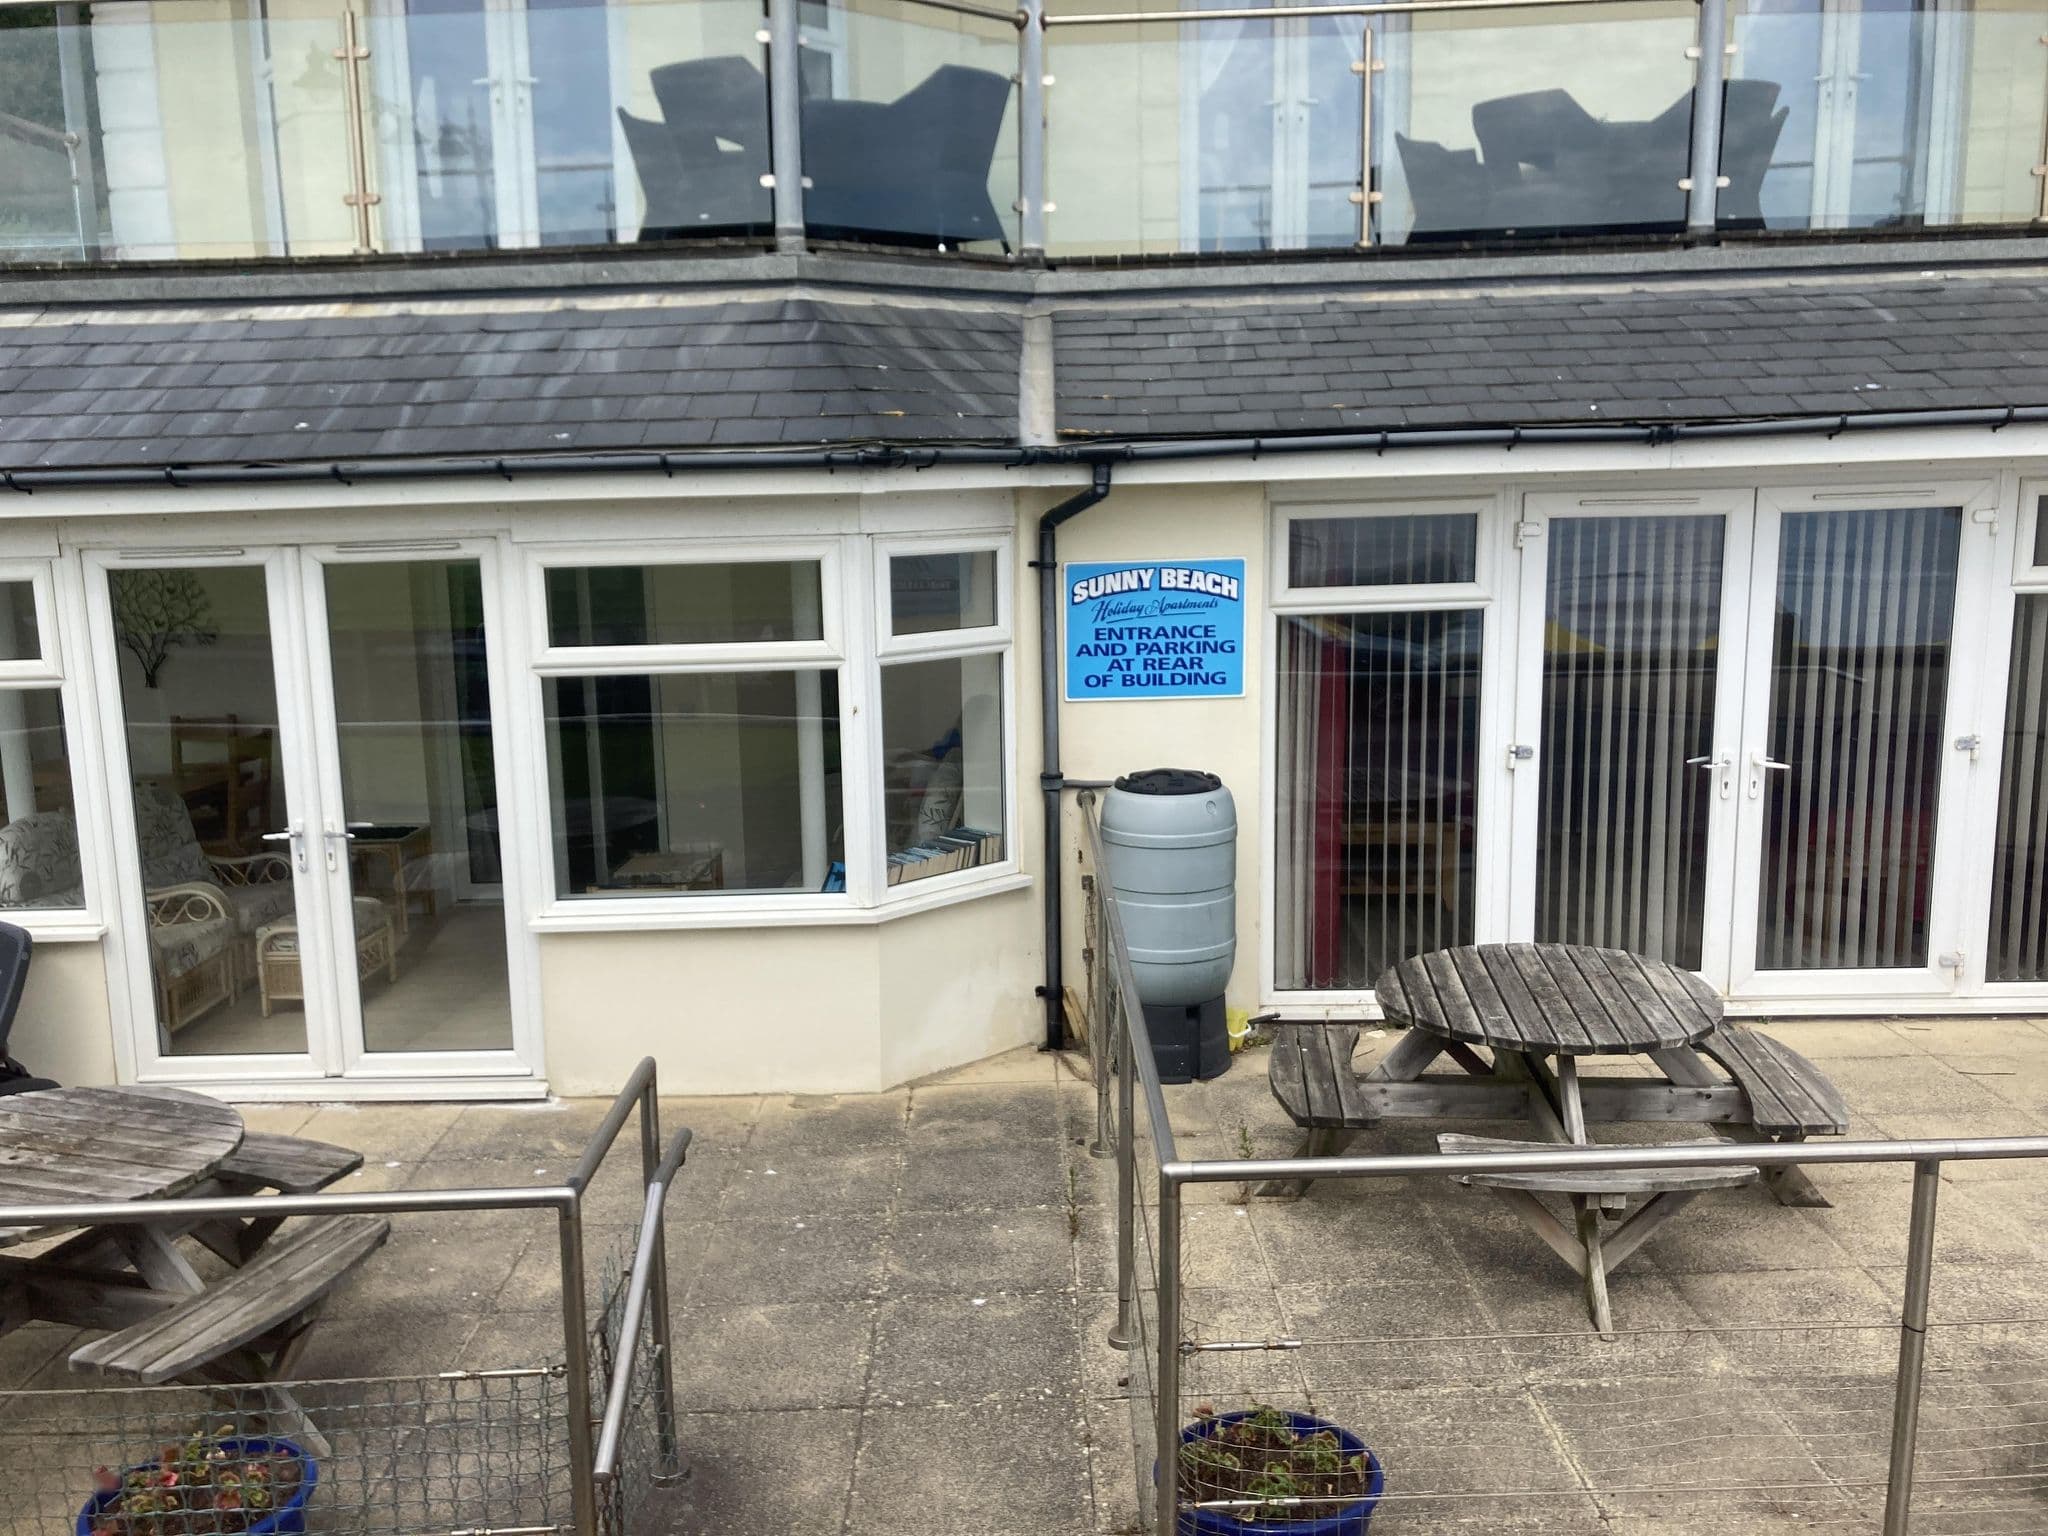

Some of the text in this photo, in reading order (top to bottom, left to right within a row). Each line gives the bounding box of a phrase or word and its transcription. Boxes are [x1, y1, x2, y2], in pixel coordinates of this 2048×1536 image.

[1072, 567, 1239, 605] SUNNY BEACH
[1092, 597, 1218, 624] Holiday Apartments
[1094, 625, 1216, 641] ENTRANCE
[1076, 640, 1235, 657] AND PARKING
[1107, 657, 1203, 672] AT REAR
[1084, 672, 1227, 688] OF BUILDING
